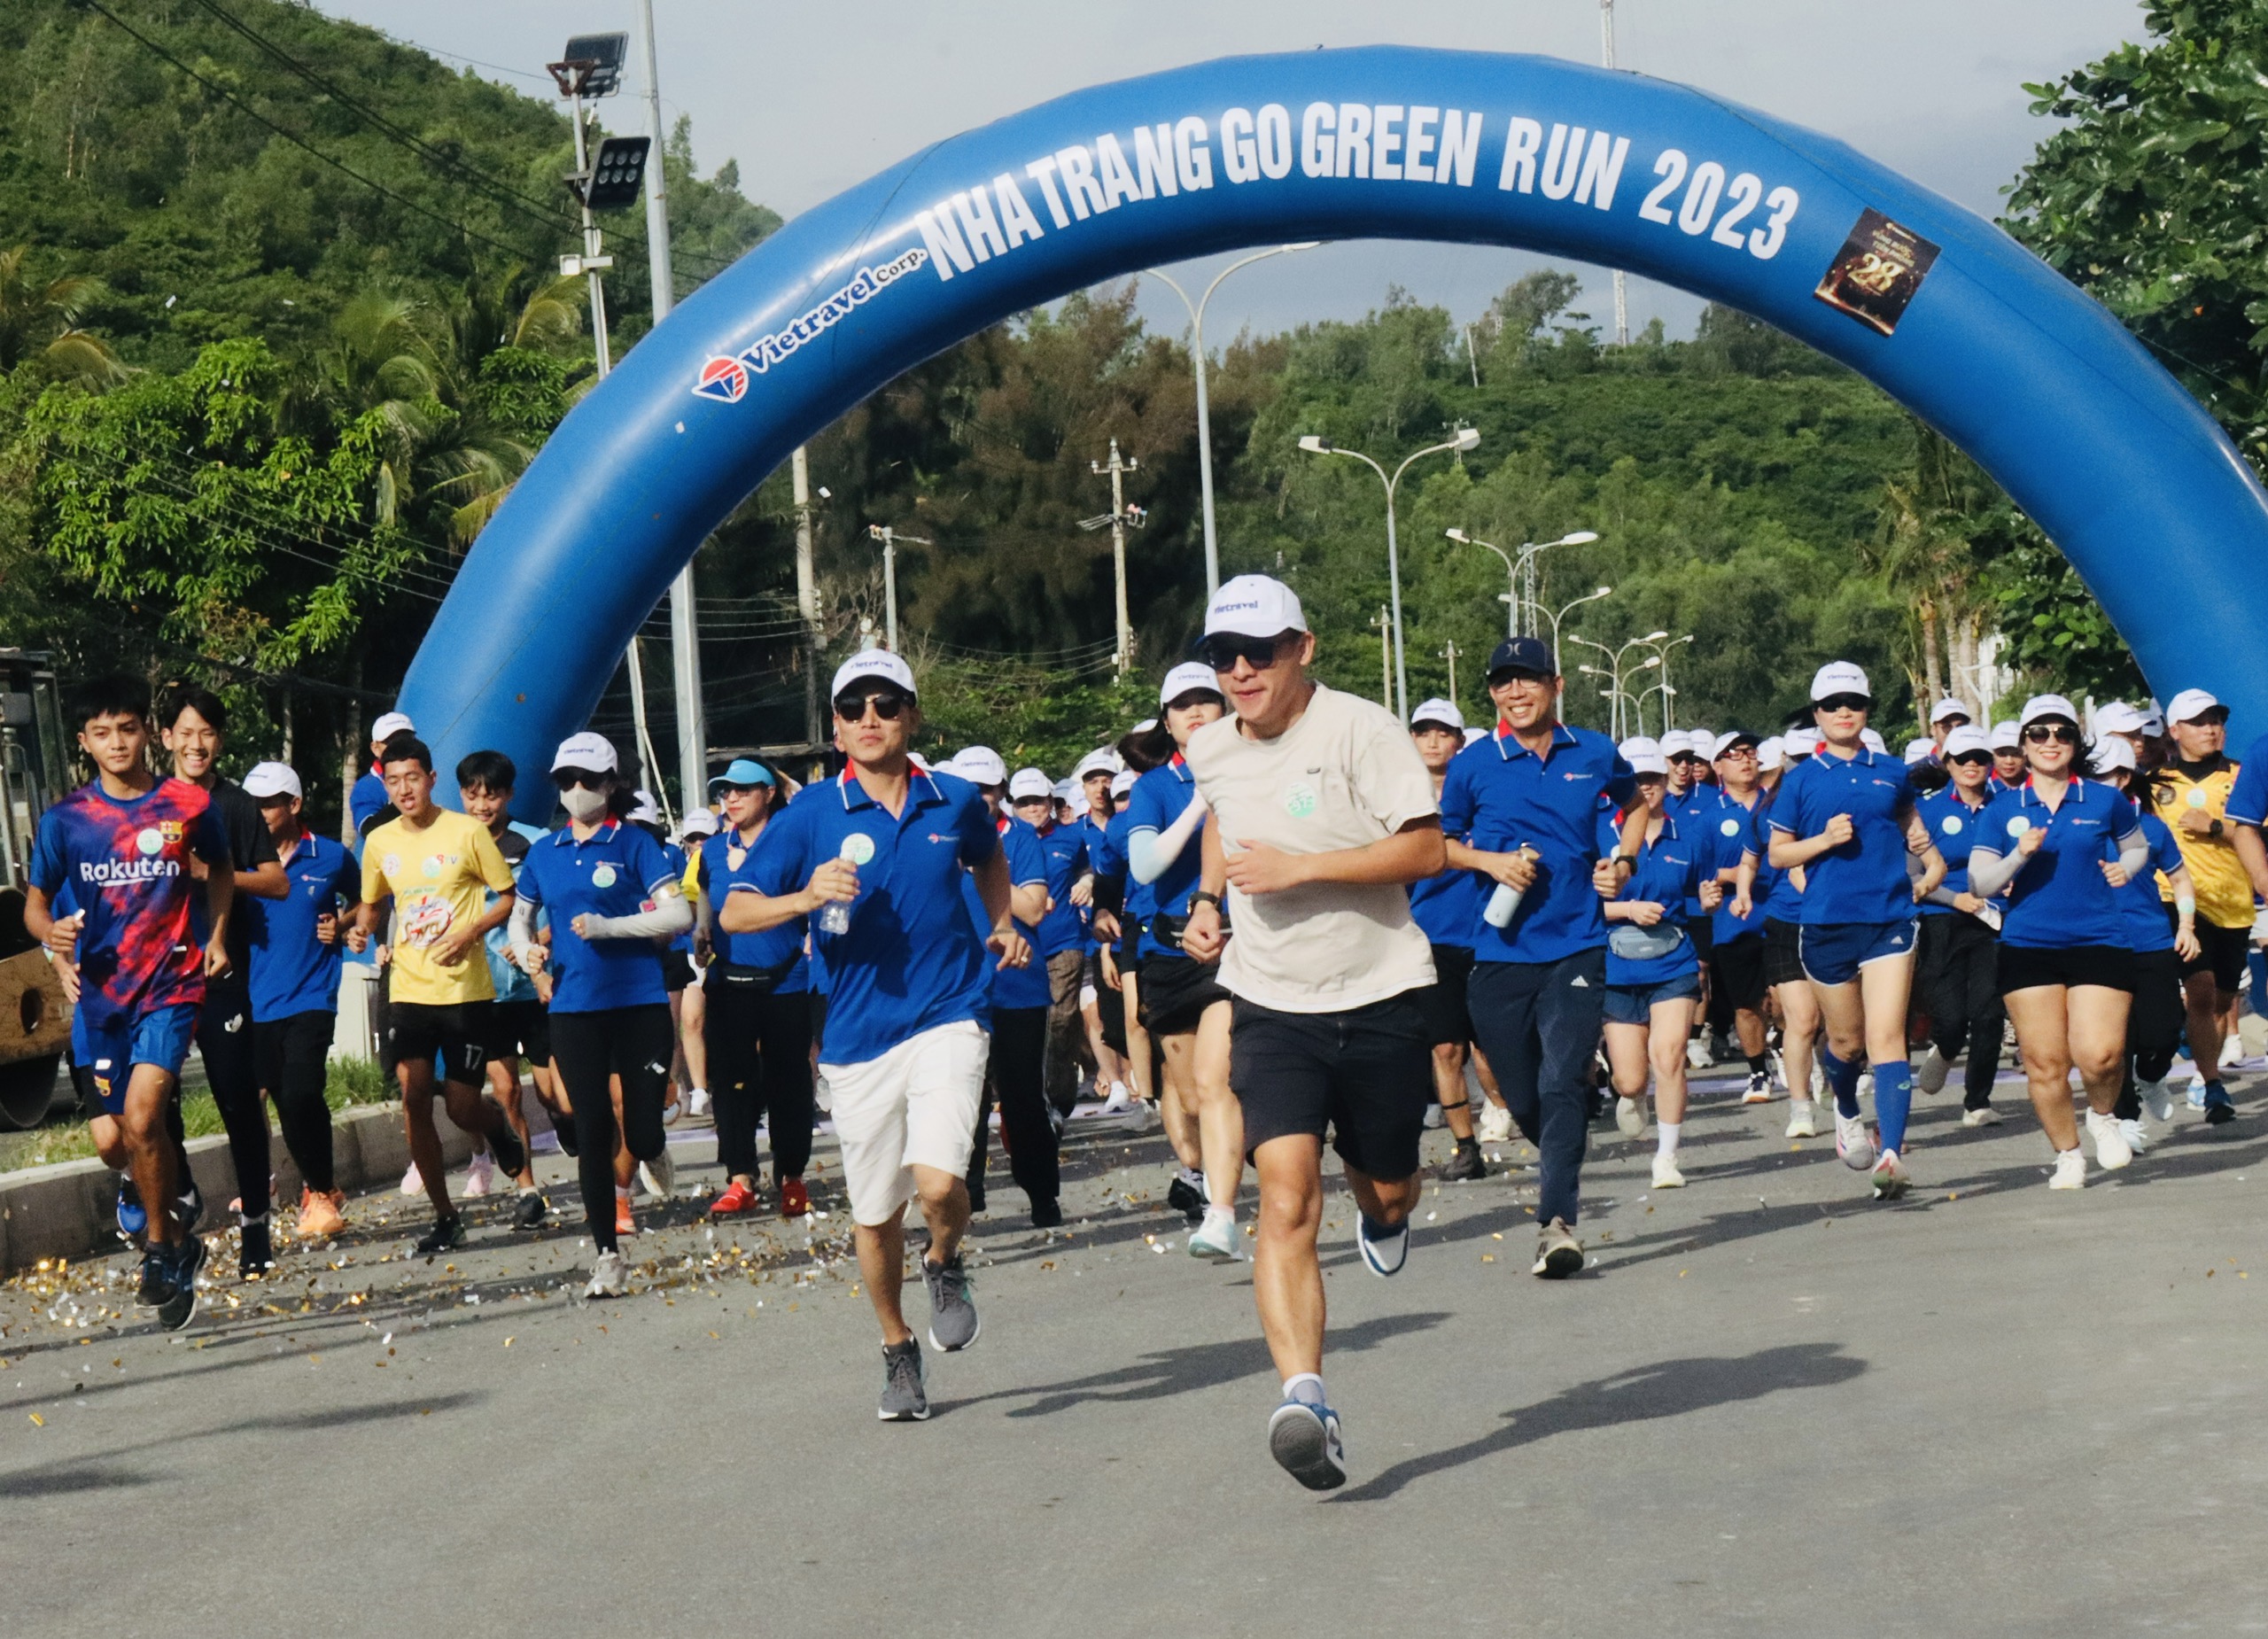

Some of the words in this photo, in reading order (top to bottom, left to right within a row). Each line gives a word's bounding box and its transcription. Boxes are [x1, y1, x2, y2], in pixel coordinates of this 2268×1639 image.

[914, 174, 1044, 281] NHA
[1025, 116, 1213, 229] TRANG
[1220, 103, 1292, 183] GO
[1301, 102, 1482, 188] GREEN
[1498, 116, 1630, 210] RUN
[1639, 149, 1801, 260] 2023
[1847, 252, 1906, 291] 28
[80, 857, 181, 882] Rakuten
[465, 1044, 484, 1070] 17
